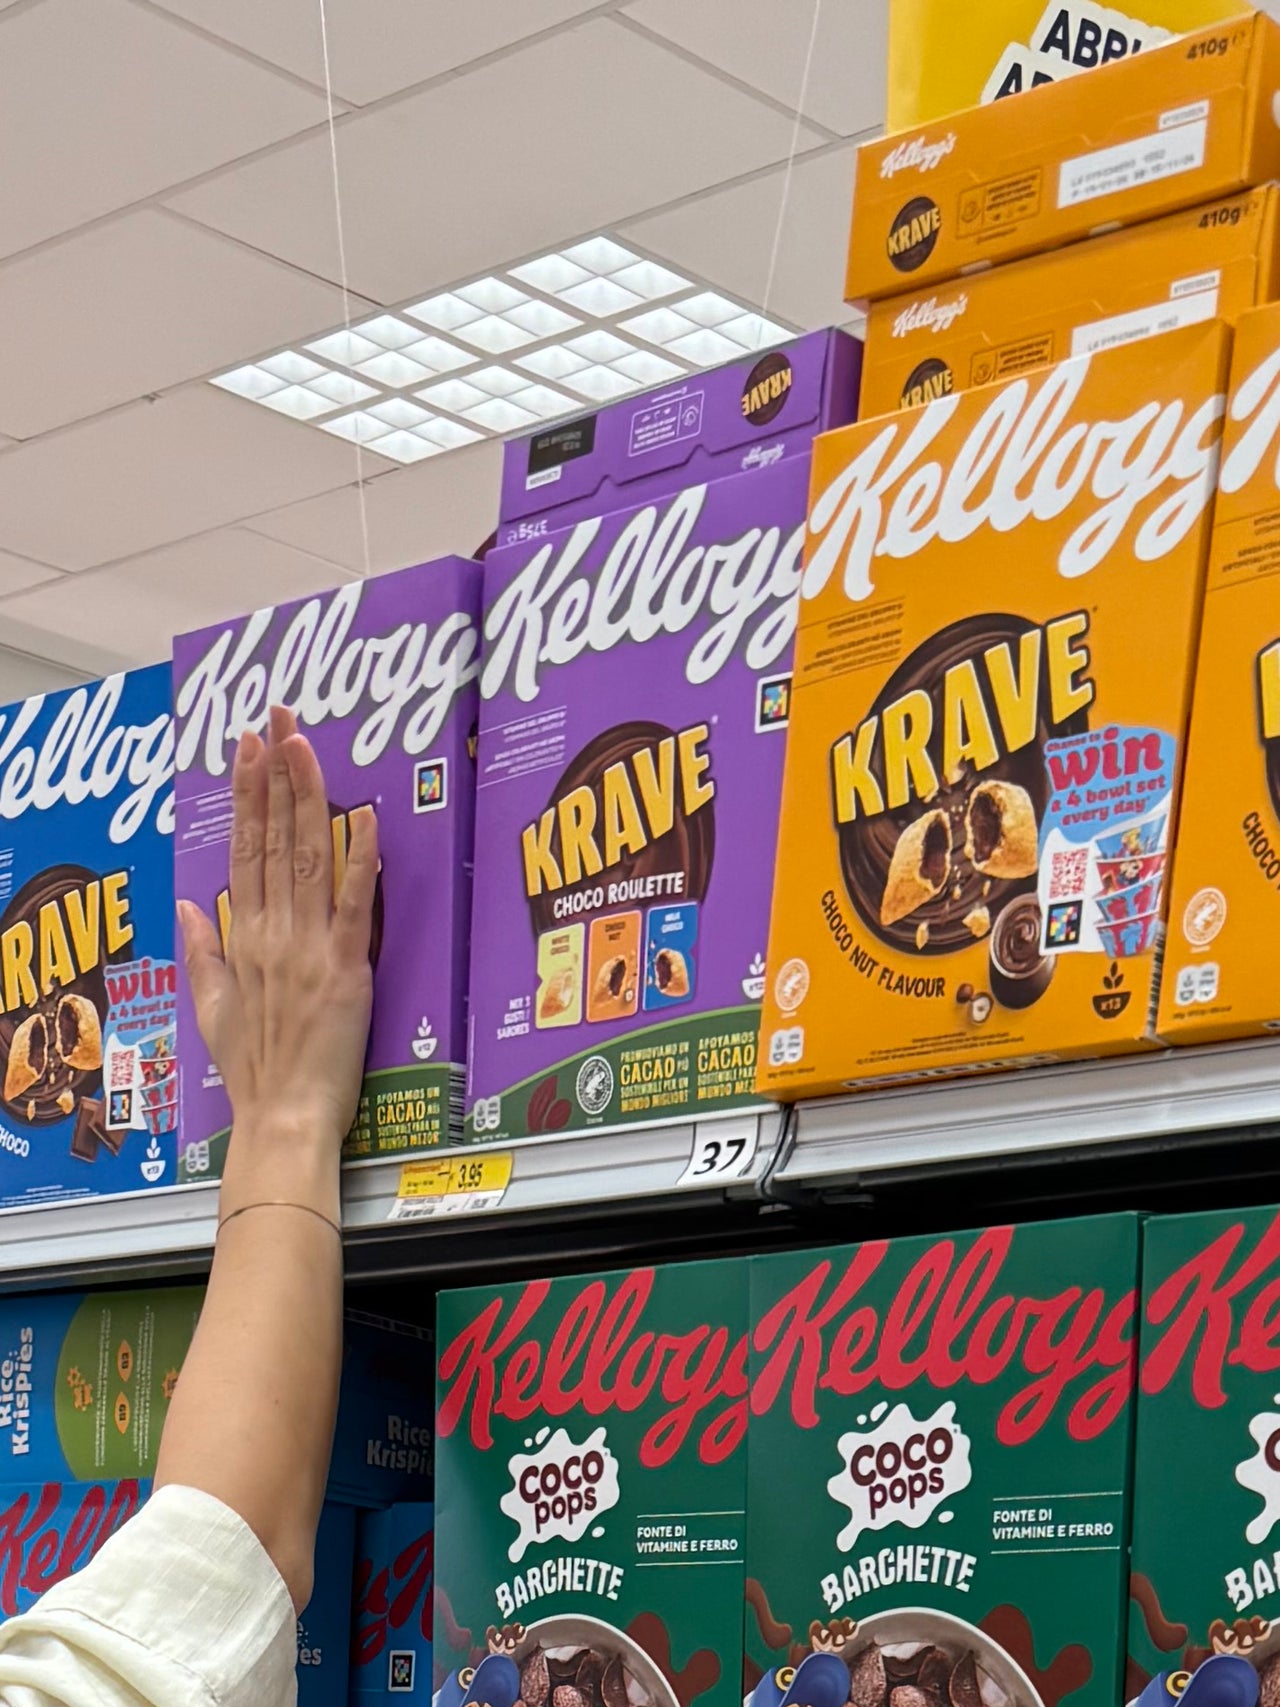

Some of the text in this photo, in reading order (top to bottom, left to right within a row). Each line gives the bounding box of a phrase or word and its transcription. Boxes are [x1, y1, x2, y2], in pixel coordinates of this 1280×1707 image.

[1187, 39, 1229, 61] 410g
[888, 208, 942, 257] KRAVE
[1198, 207, 1240, 230] 410g
[829, 611, 1095, 826] KRAVE
[1048, 727, 1164, 791] win
[522, 722, 716, 899] KRAVE
[553, 871, 685, 919] CHOCO ROULETTE
[821, 890, 946, 998] CHOCO NUT FLAVOUR
[621, 1058, 675, 1085] CACAO
[697, 1045, 755, 1072] CACAO
[693, 1138, 746, 1176] 37
[518, 1448, 605, 1504] COCO
[849, 1425, 956, 1487] COCO
[534, 1488, 597, 1533] pops
[868, 1466, 945, 1512] pops
[494, 1563, 625, 1618] BARCHETTE
[820, 1552, 978, 1615] BARCHETTE
